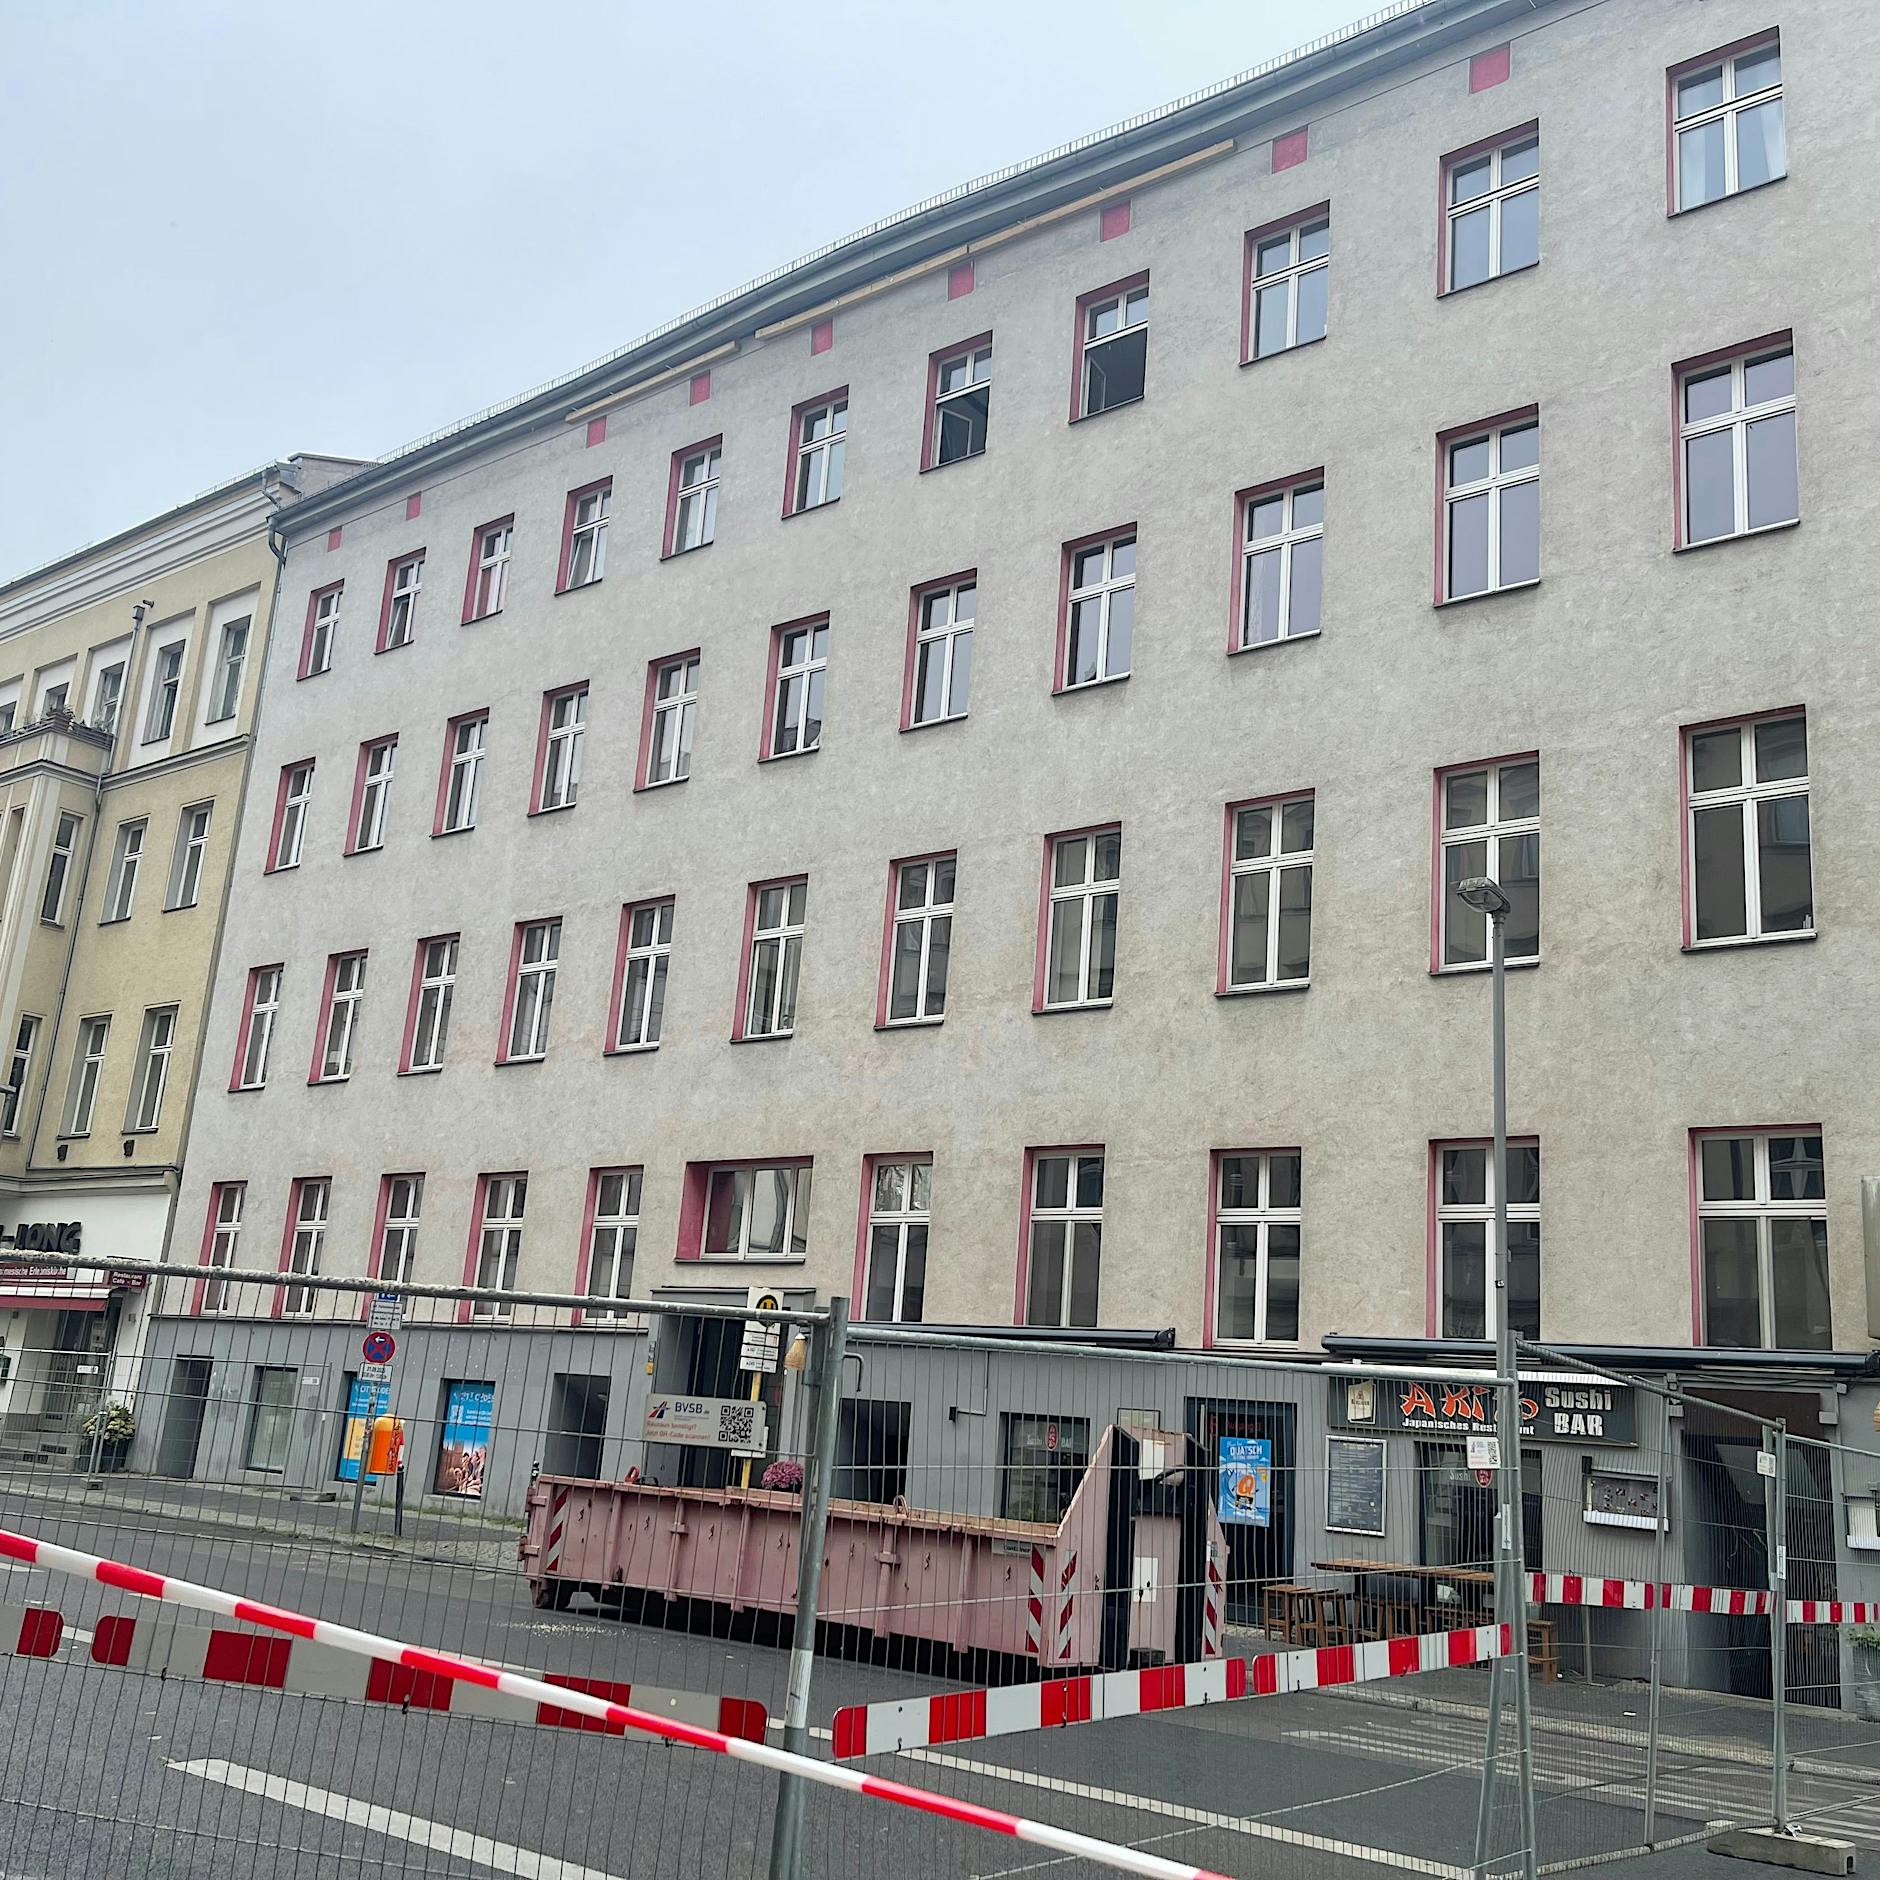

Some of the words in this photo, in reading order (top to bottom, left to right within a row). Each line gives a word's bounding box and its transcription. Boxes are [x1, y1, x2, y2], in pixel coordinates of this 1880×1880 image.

[1545, 1386, 1612, 1411] Sushi
[1402, 1417, 1469, 1431] Japanisches
[1472, 1421, 1535, 1435] Restnt
[1554, 1412, 1604, 1437] BAR
